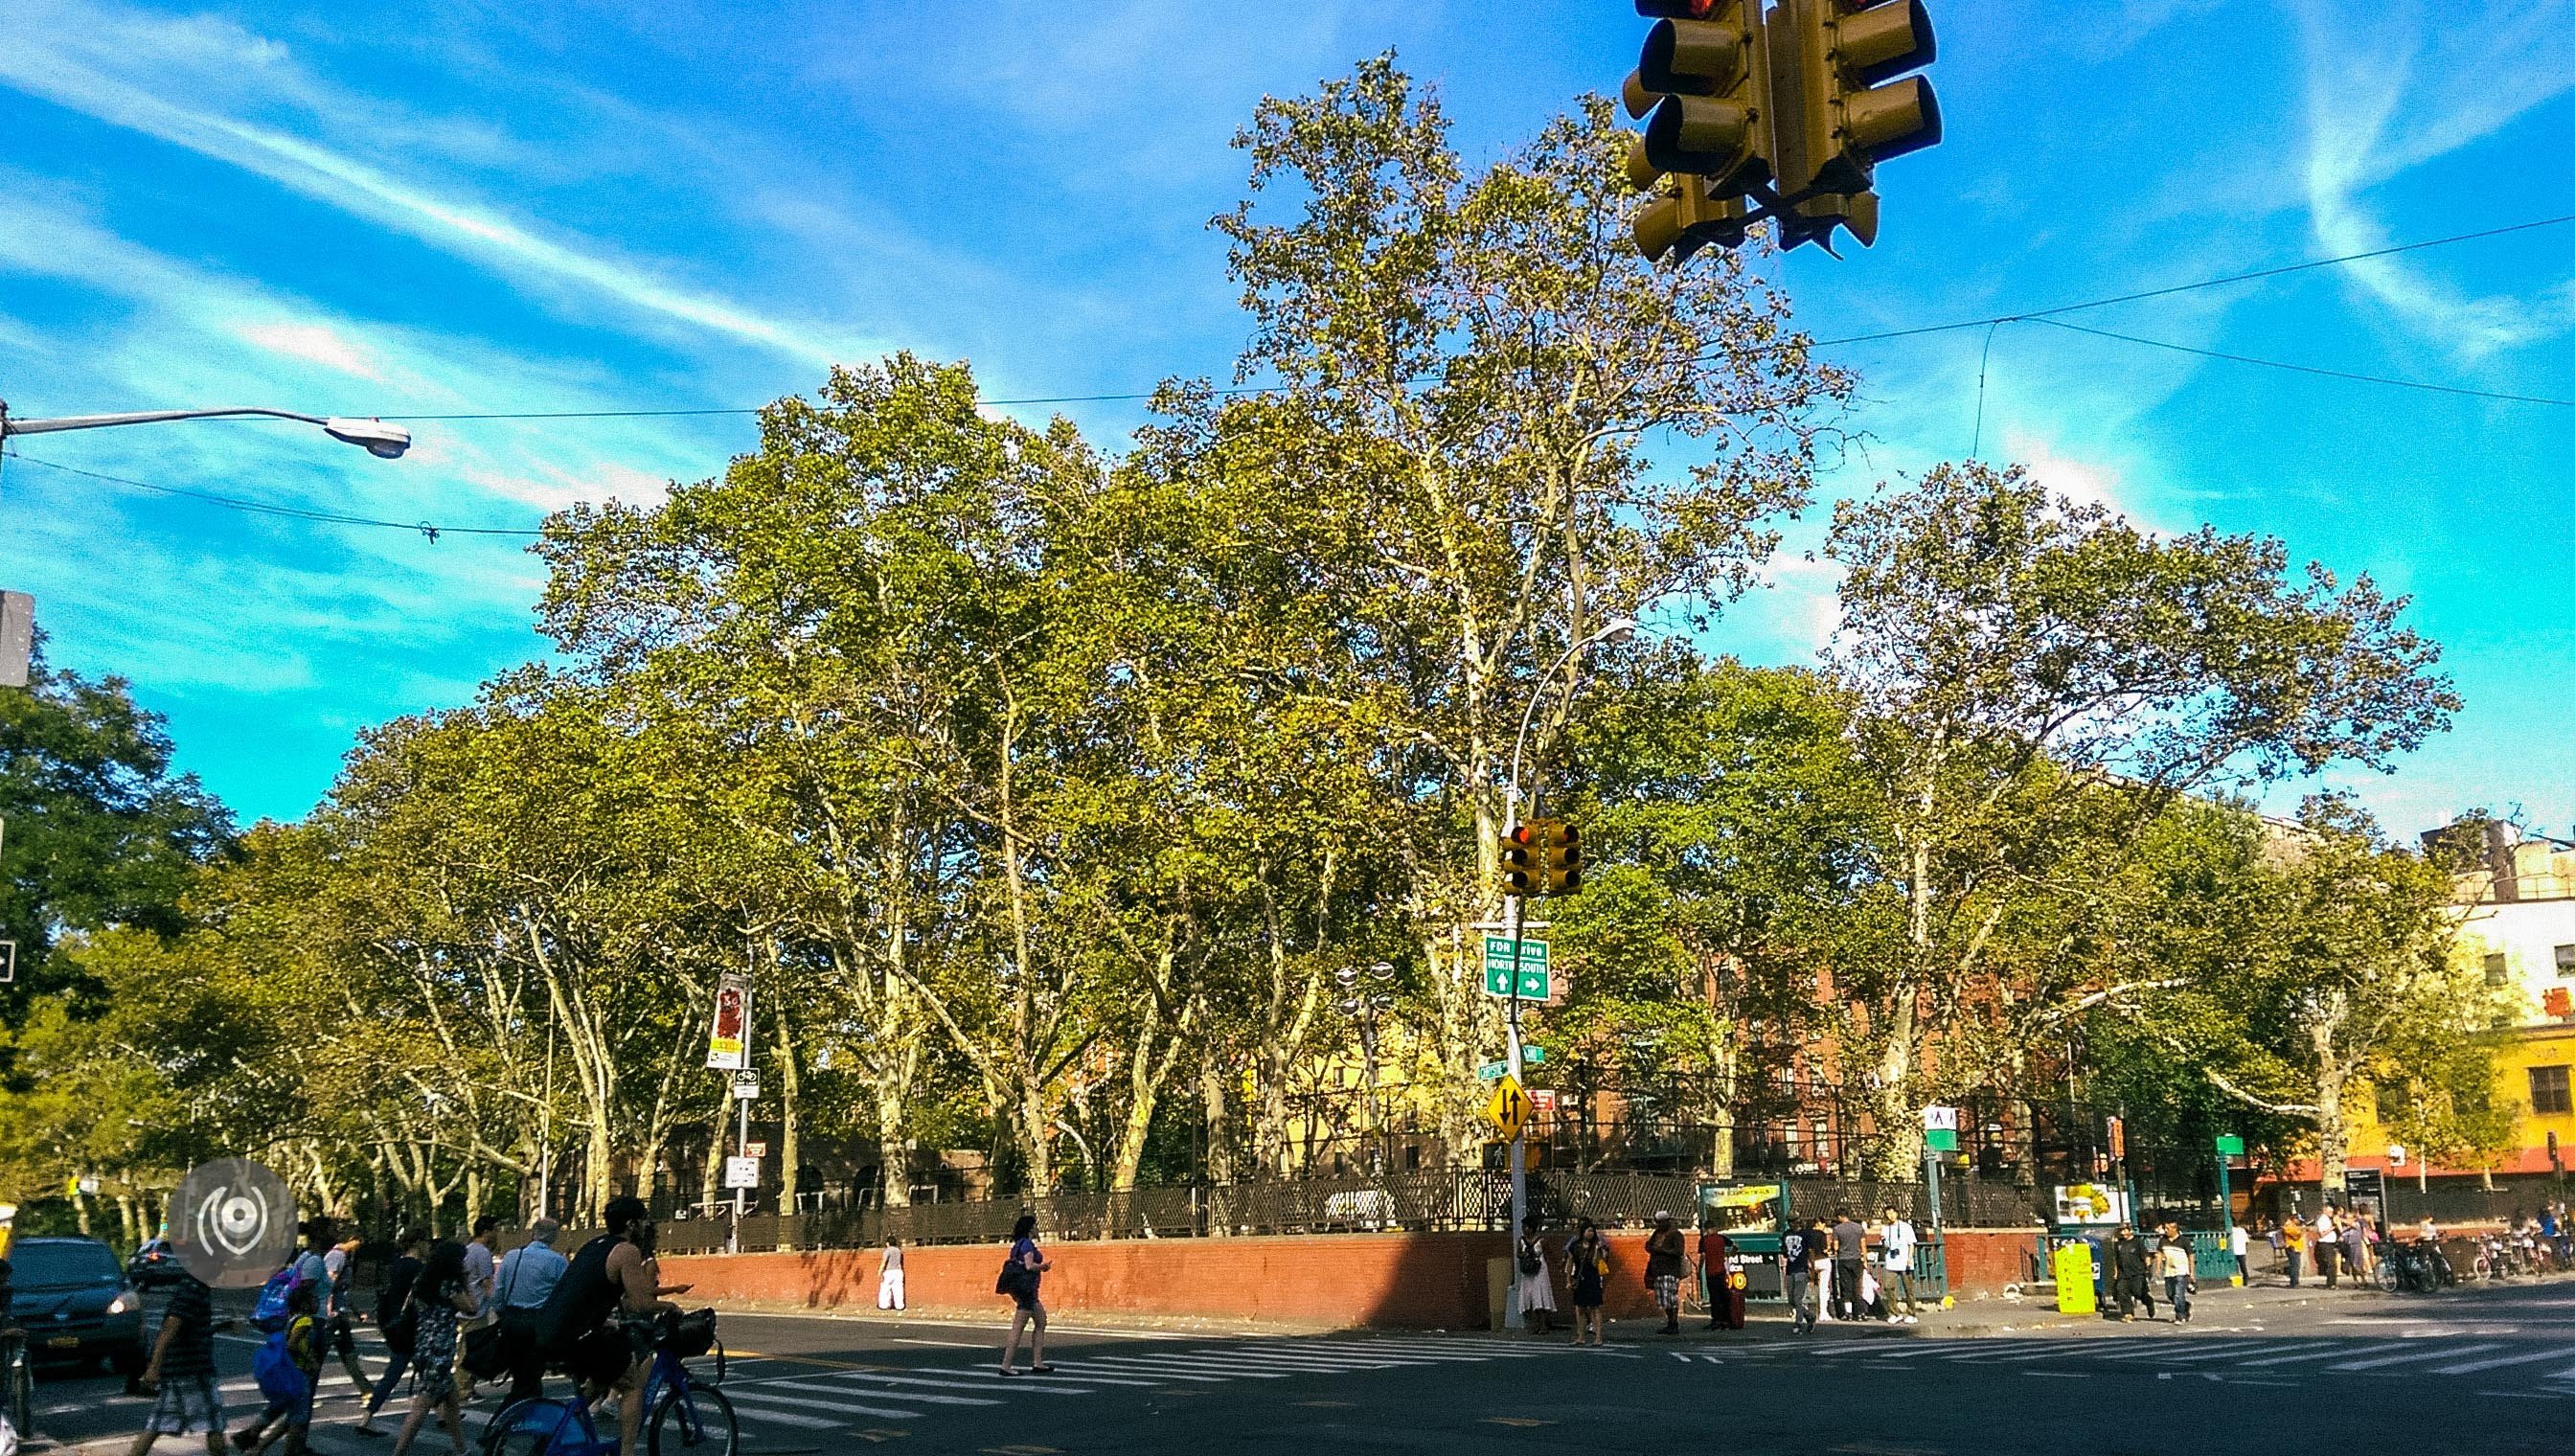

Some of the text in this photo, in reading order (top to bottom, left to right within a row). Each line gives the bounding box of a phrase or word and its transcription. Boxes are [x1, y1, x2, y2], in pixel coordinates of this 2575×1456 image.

[1490, 942, 1542, 957] FDR rive
[1487, 959, 1515, 971] NORTH
[1519, 962, 1546, 974] SOUTH
[1740, 1254, 1764, 1264] Street
